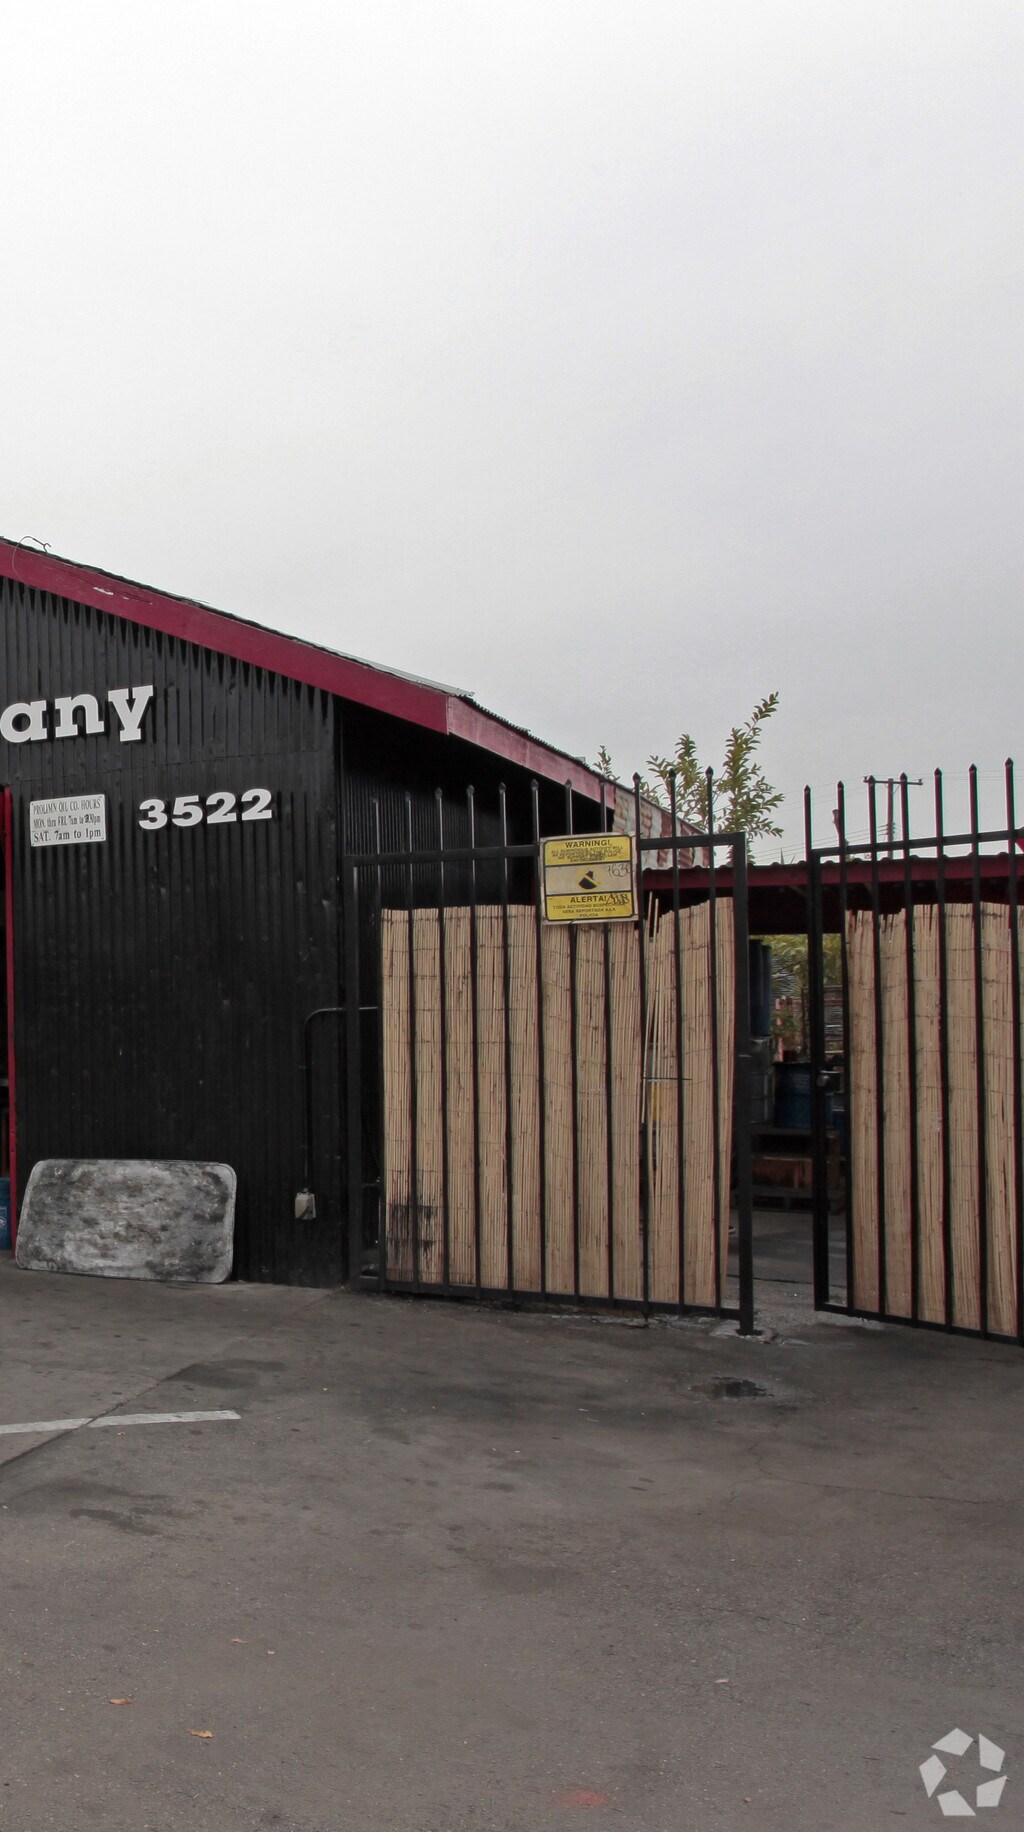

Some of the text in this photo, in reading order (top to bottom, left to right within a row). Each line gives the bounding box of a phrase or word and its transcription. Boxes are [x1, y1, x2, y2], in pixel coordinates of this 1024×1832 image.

[81, 799, 100, 810] HOURS
[138, 787, 273, 830] 3522
[34, 828, 101, 842] SAT. 7am to 1pm
[565, 839, 610, 848] WARNING!
[570, 895, 607, 904] ALERTA!
